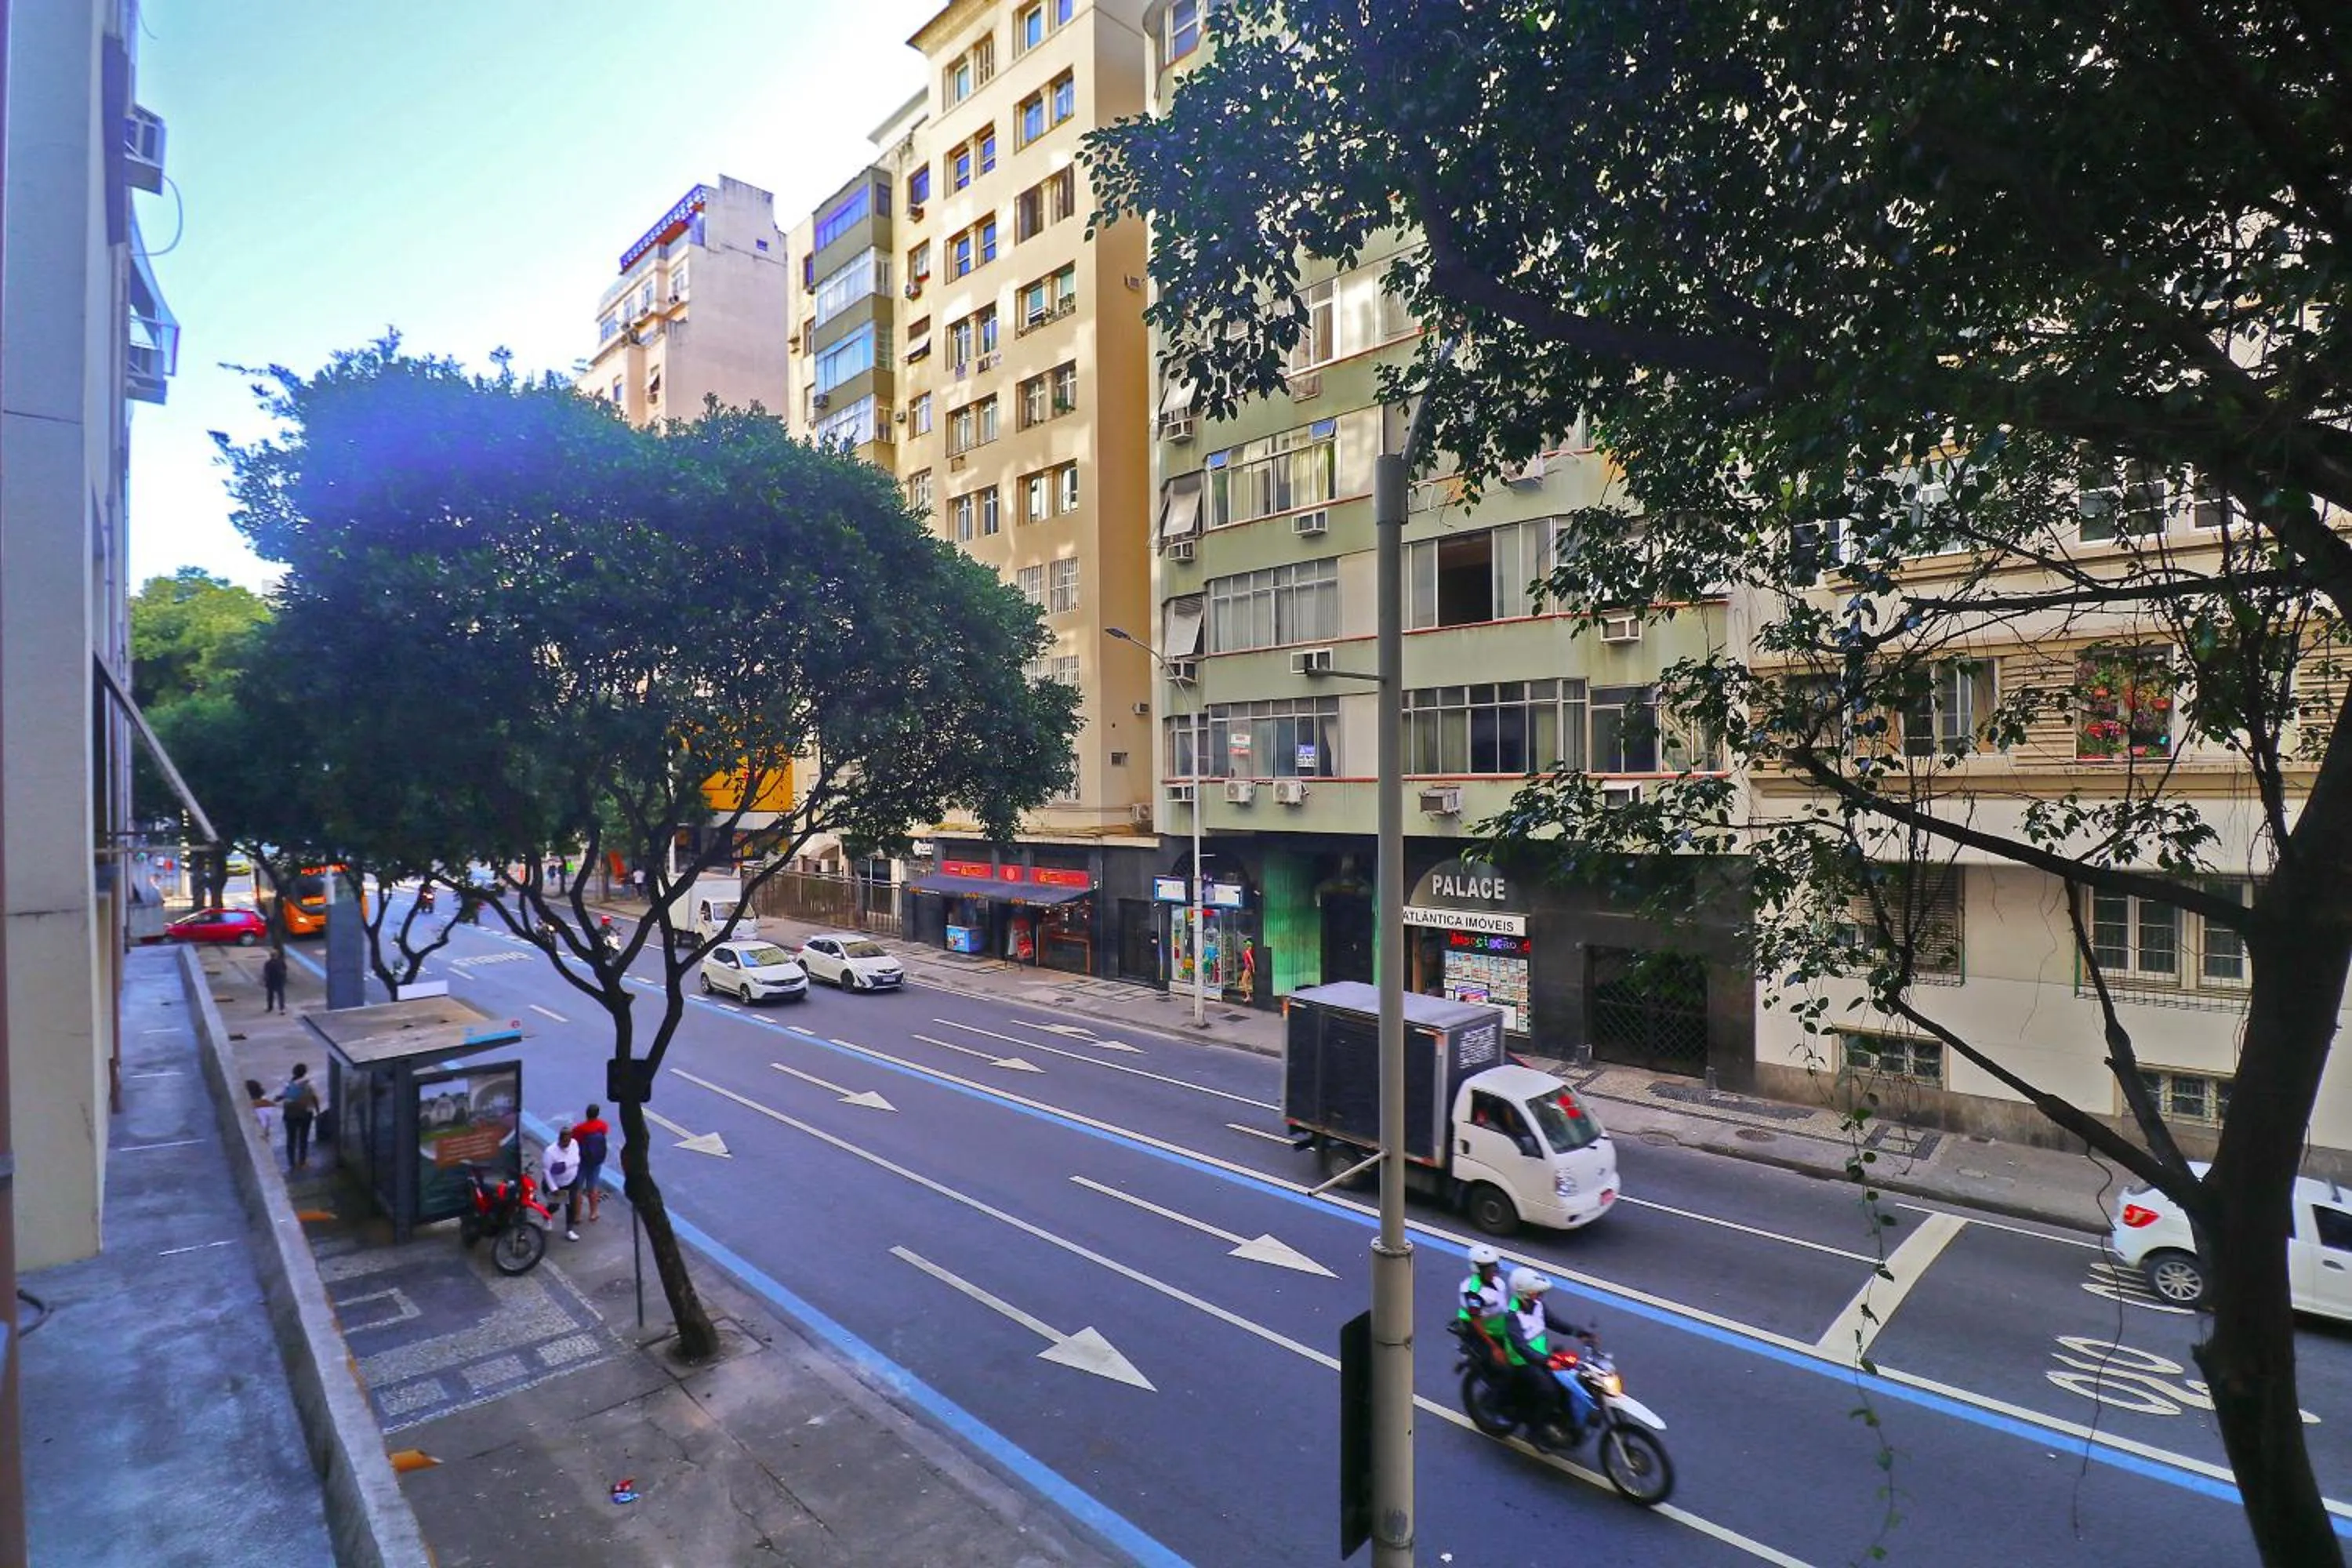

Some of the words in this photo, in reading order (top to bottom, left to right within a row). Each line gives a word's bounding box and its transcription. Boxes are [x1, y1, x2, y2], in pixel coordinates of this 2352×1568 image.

[1432, 875, 1505, 900] PALACE
[1403, 910, 1463, 926] ATLÂNTICA
[1465, 916, 1514, 931] IMÓVEIS
